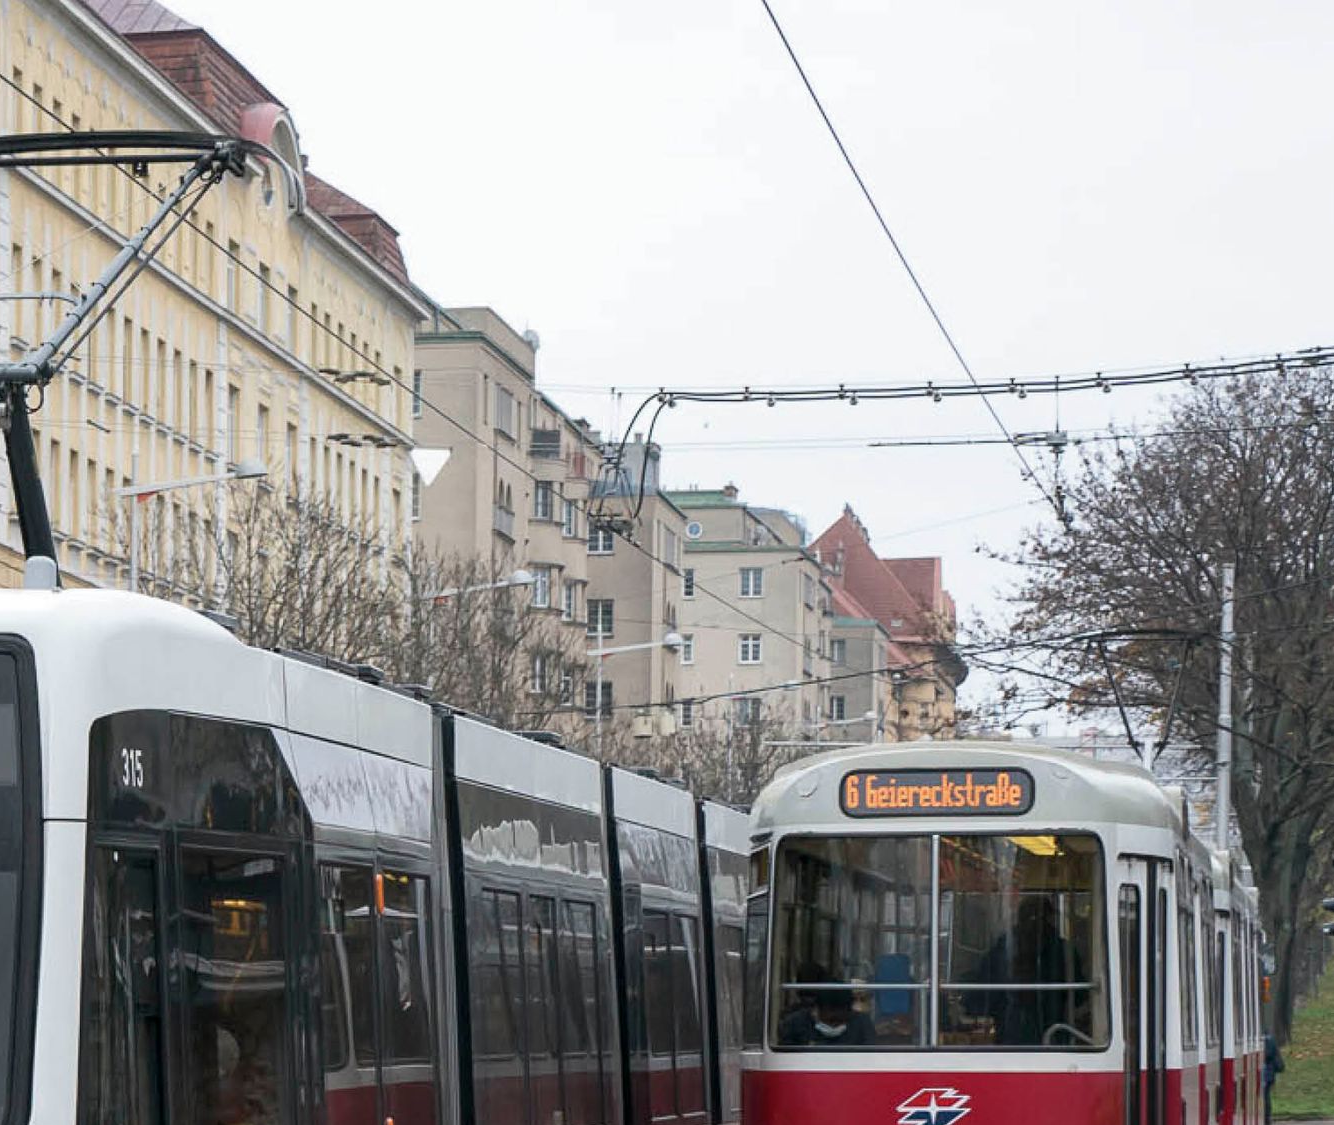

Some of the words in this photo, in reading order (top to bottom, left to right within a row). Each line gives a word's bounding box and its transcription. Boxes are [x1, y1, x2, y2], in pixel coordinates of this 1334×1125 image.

[121, 747, 144, 788] 315
[845, 775, 859, 809] 6
[865, 773, 1022, 808] Geiereckstraße
